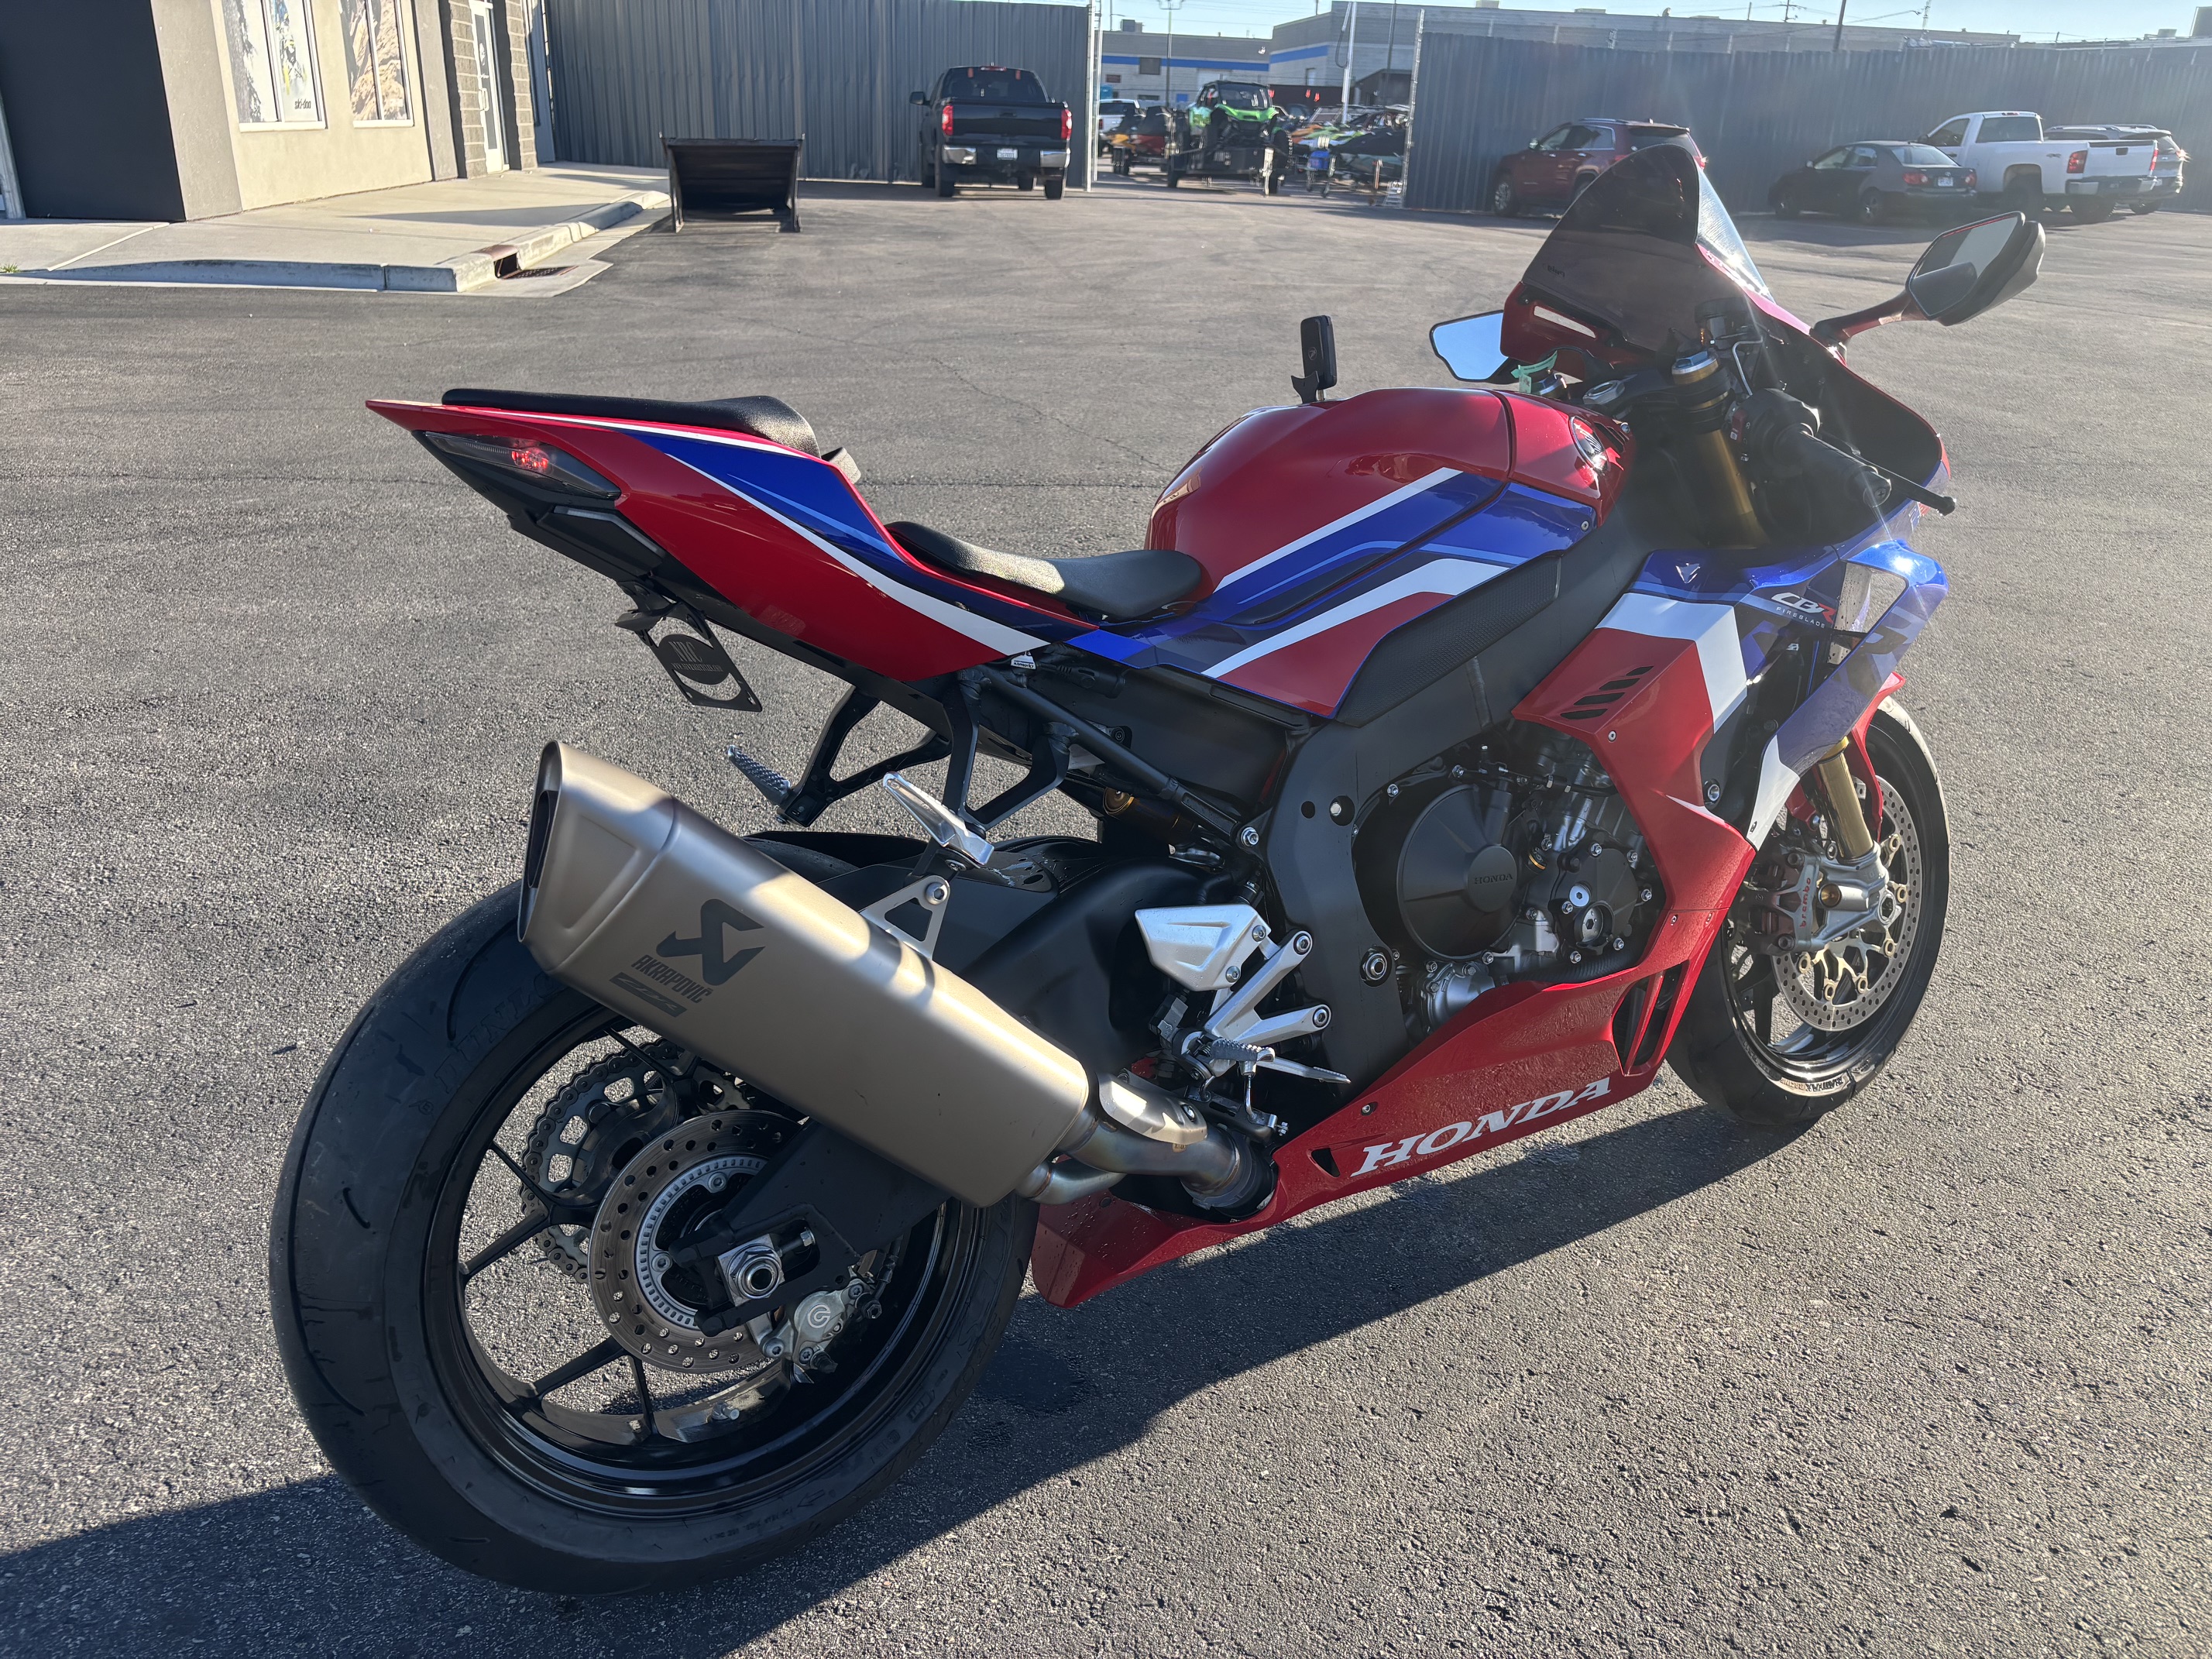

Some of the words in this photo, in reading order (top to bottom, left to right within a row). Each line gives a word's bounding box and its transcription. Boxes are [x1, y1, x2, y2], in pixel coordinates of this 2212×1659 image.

[1771, 592, 1836, 624] CBR
[1776, 606, 1826, 628] FIREBLADE
[1474, 874, 1513, 884] HONDA
[1799, 878, 1812, 928] brembo
[631, 954, 713, 1003] AKRAPOVIČ
[434, 970, 558, 1094] DUNLO
[1351, 1077, 1611, 1176] HONDA
